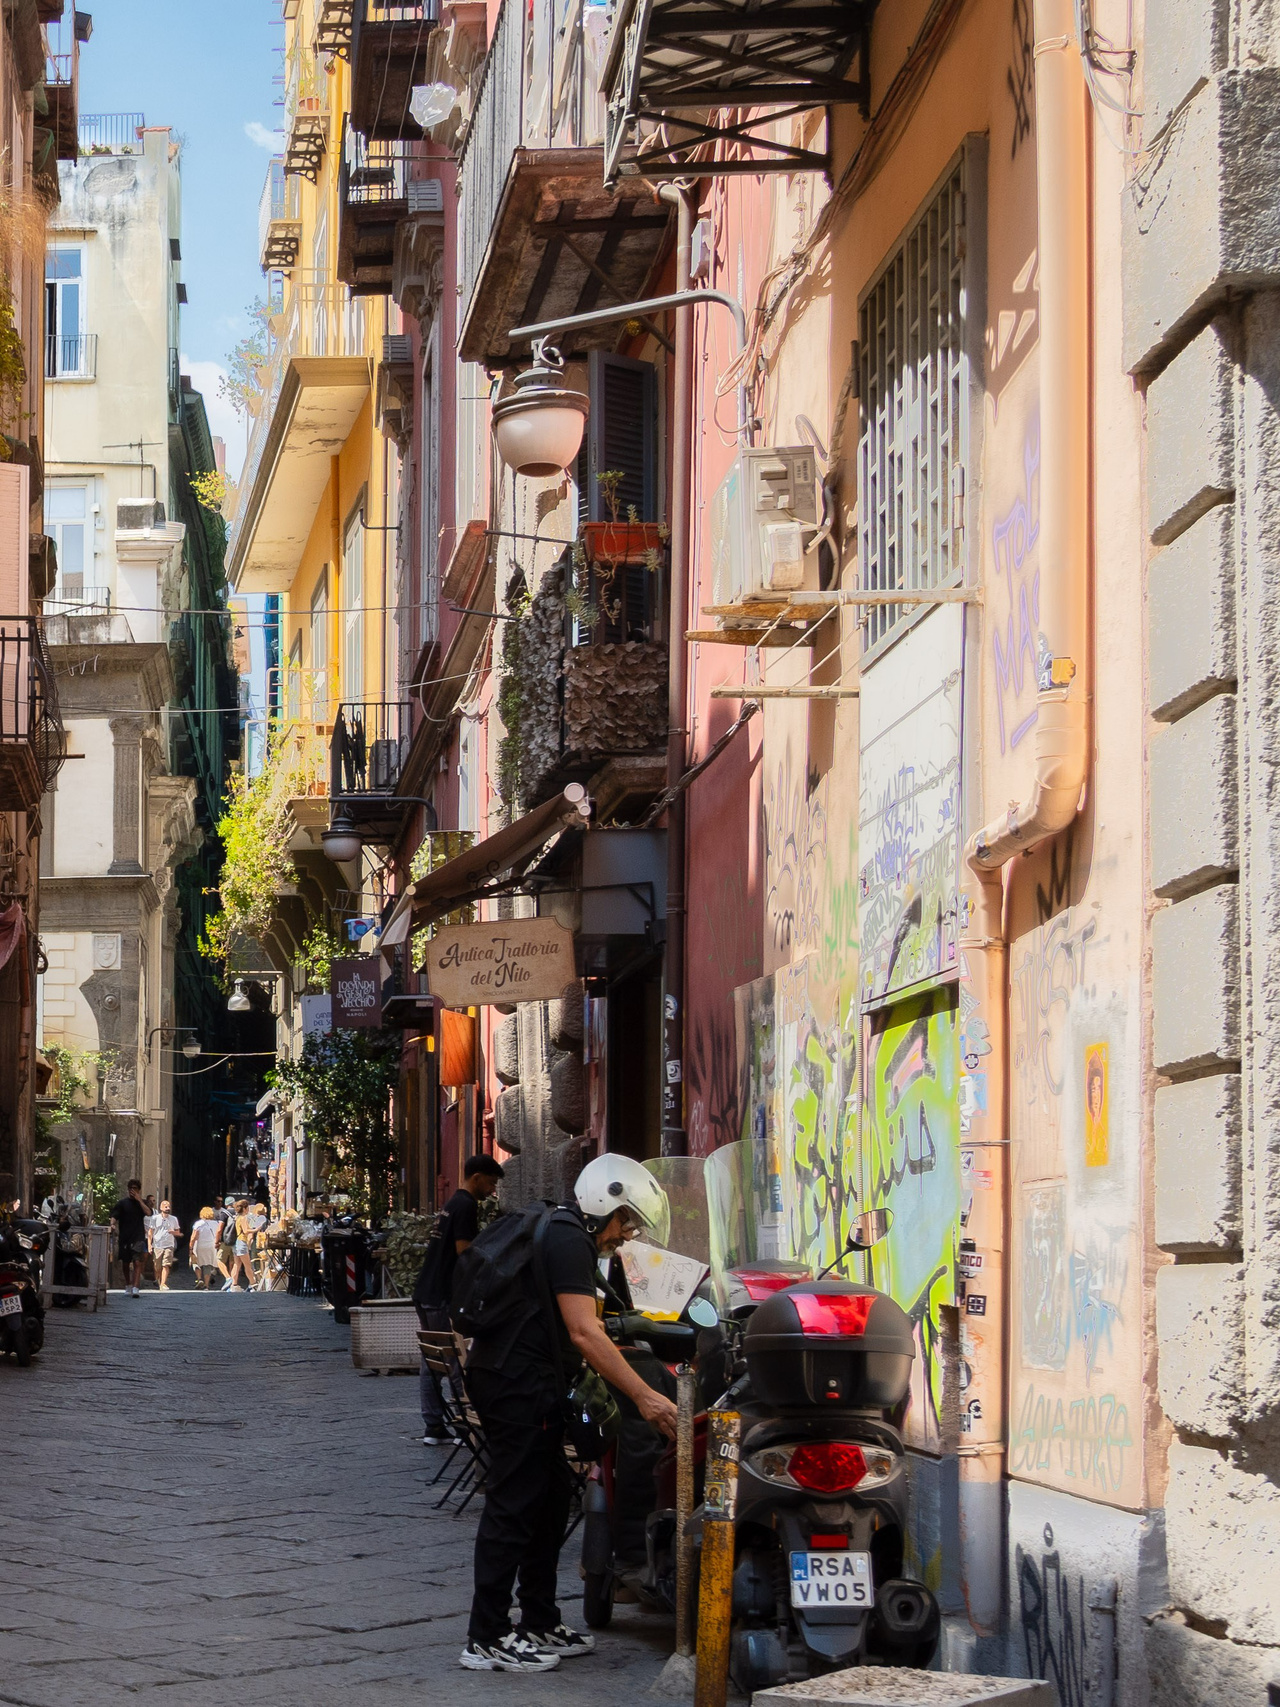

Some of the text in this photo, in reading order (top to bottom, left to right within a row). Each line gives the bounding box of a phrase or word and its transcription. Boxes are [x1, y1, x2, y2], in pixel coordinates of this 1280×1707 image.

[439, 937, 560, 969] Antica Trattoria
[470, 961, 531, 988] del Nilo
[338, 980, 375, 993] LOCANDA
[336, 995, 376, 1008] VECCHIO
[793, 1569, 808, 1579] PL
[810, 1556, 855, 1577] RSA
[799, 1582, 866, 1602] VW05
